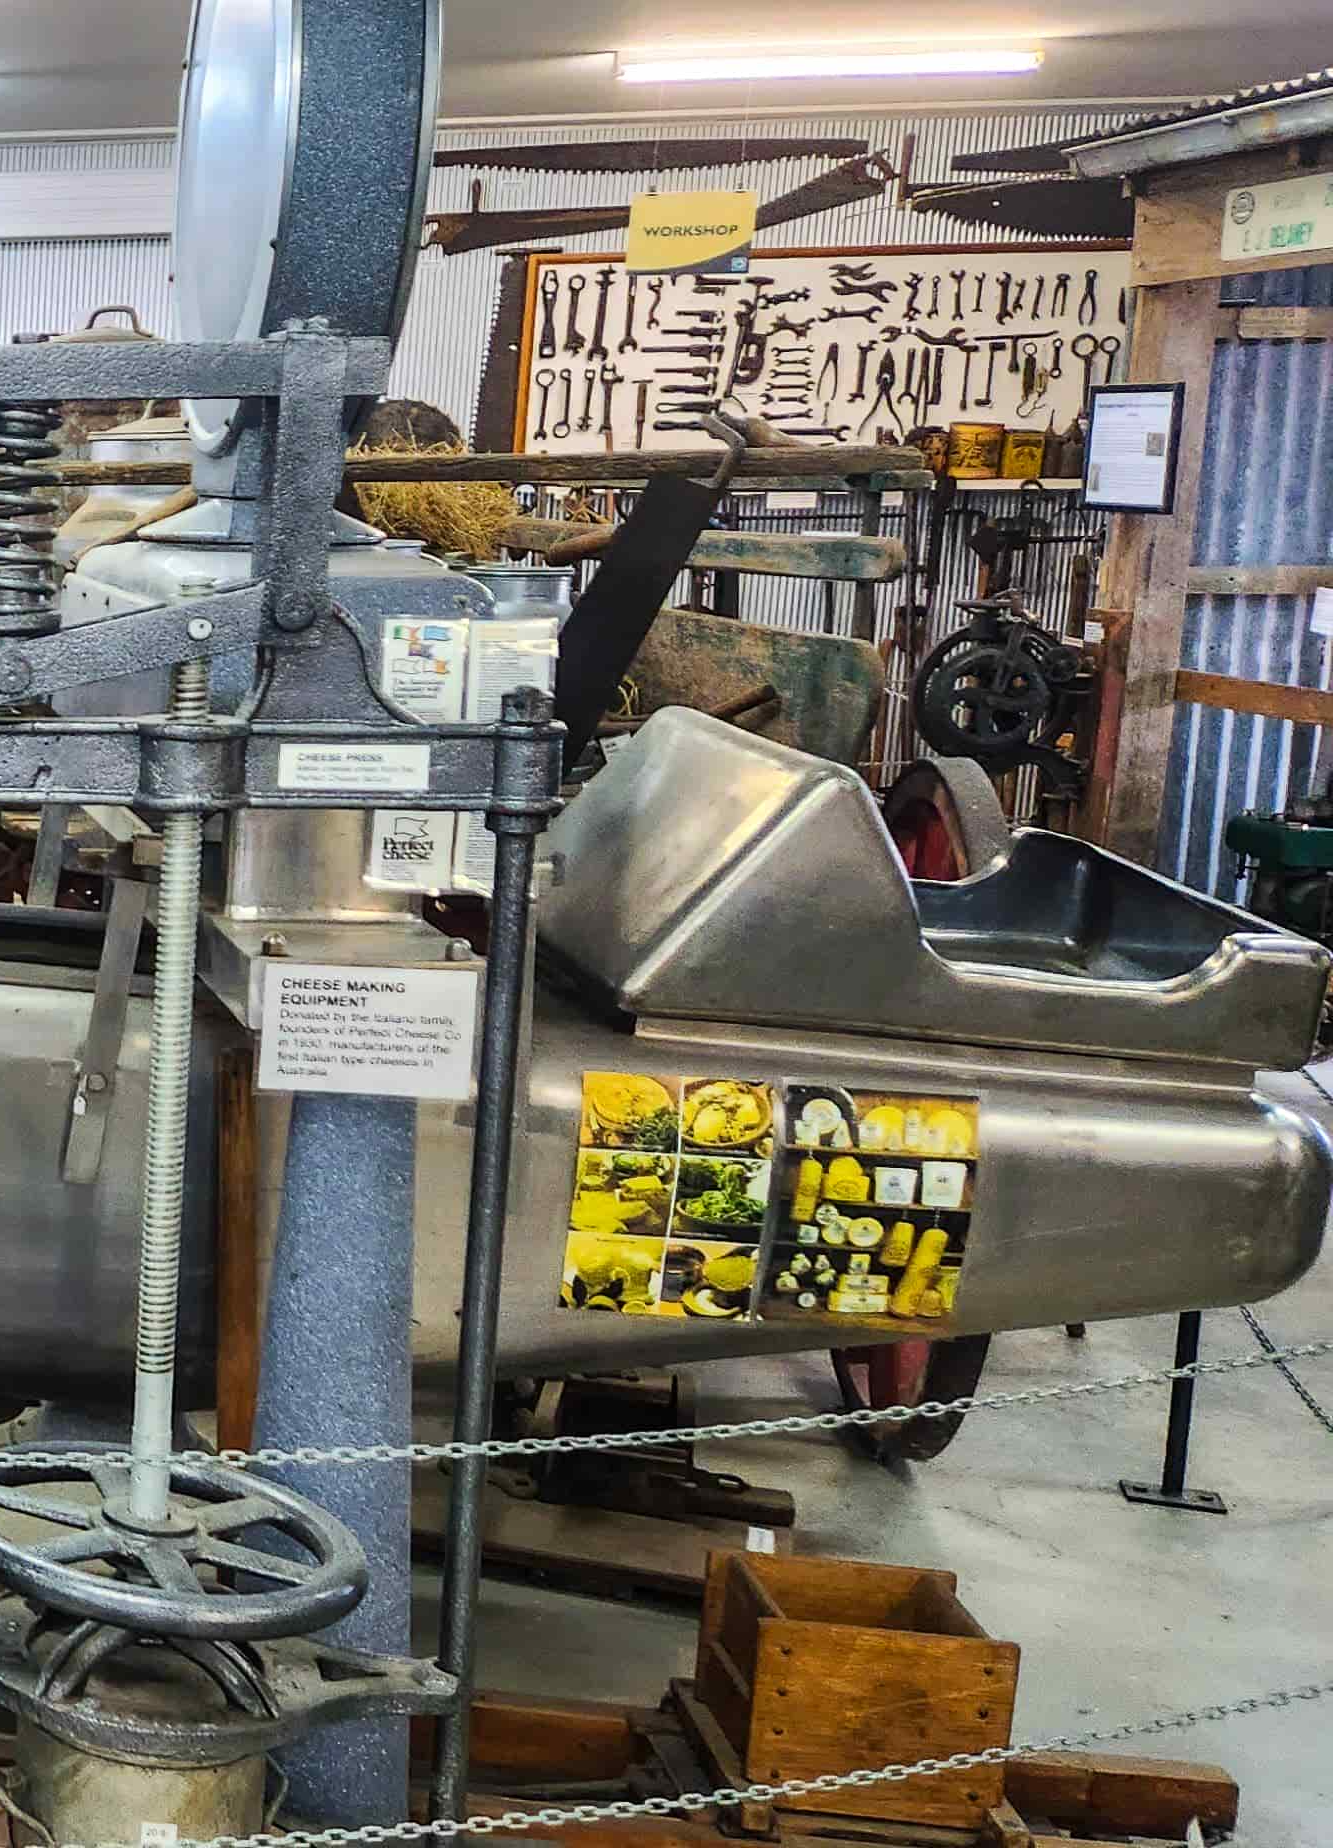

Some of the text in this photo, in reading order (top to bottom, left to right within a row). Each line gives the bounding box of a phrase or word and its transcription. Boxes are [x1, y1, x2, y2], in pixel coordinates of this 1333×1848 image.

[643, 224, 739, 238] WORKSHOP
[296, 752, 384, 762] CHEESE PRESS
[382, 836, 434, 850] Perfect
[382, 849, 431, 860] cheese
[281, 977, 406, 993] CHEESE MAKING
[280, 993, 368, 1007] EQUIPMENT
[279, 1008, 330, 1021] Donated
[333, 1012, 347, 1024] by
[351, 1012, 369, 1023] the
[279, 1023, 330, 1035] founders
[333, 1025, 347, 1036] of
[349, 1027, 391, 1039] Perfect
[395, 1028, 440, 1040] Cheese
[277, 1038, 289, 1048] in
[329, 1040, 415, 1053] manufacturers
[417, 1043, 431, 1054] of
[432, 1044, 451, 1056] the
[277, 1051, 435, 1068] first Italian type cheeses in
